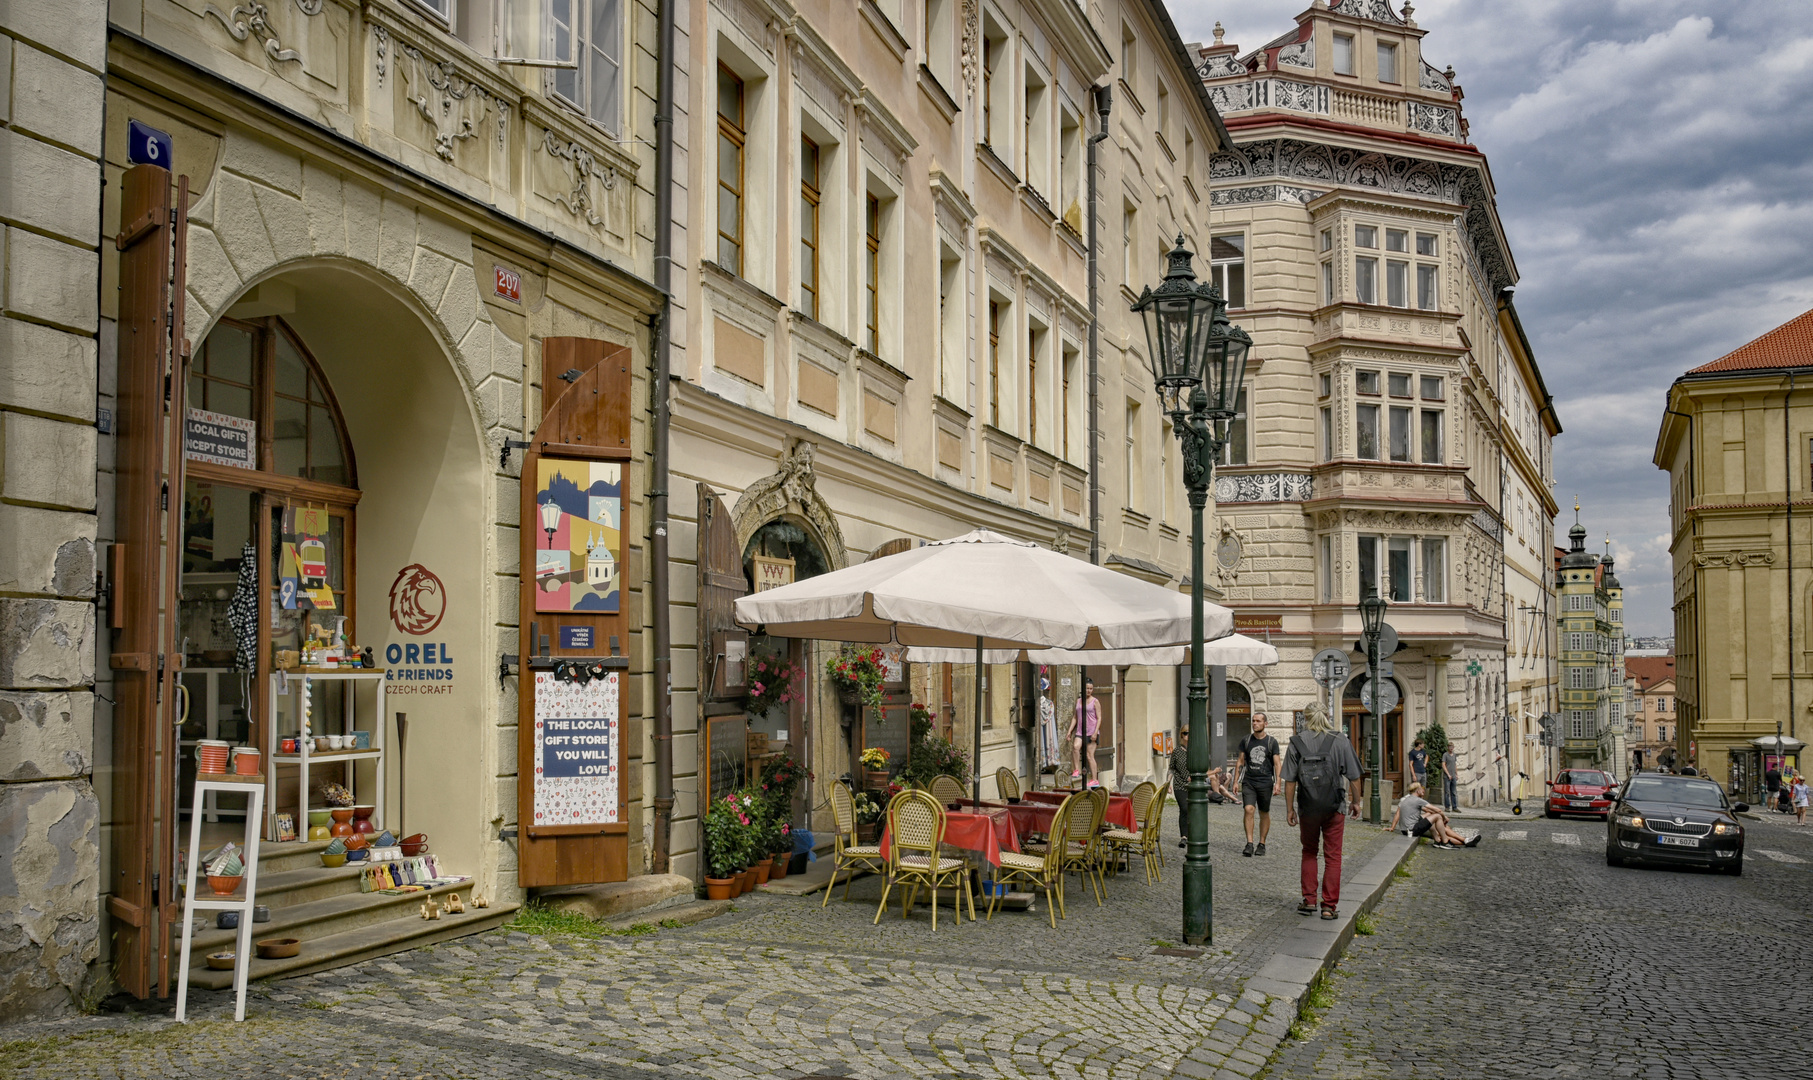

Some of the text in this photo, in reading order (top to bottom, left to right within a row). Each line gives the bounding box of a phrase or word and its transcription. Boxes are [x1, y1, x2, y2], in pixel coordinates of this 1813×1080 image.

[147, 136, 159, 160] 6
[499, 271, 518, 292] 207
[189, 422, 247, 442] LOCAL GIFTS
[187, 439, 247, 459] NCEPT STORE
[282, 580, 294, 607] 9
[386, 643, 453, 665] OREL
[386, 669, 453, 681] & FRIENDS
[386, 685, 453, 695] CZECH CRAFT
[547, 721, 608, 730] THE LOCAL
[545, 735, 608, 745] GIFT STORE
[556, 751, 608, 760] YOU WILL
[579, 765, 608, 775] LOVE
[1679, 838, 1696, 846] 6074
